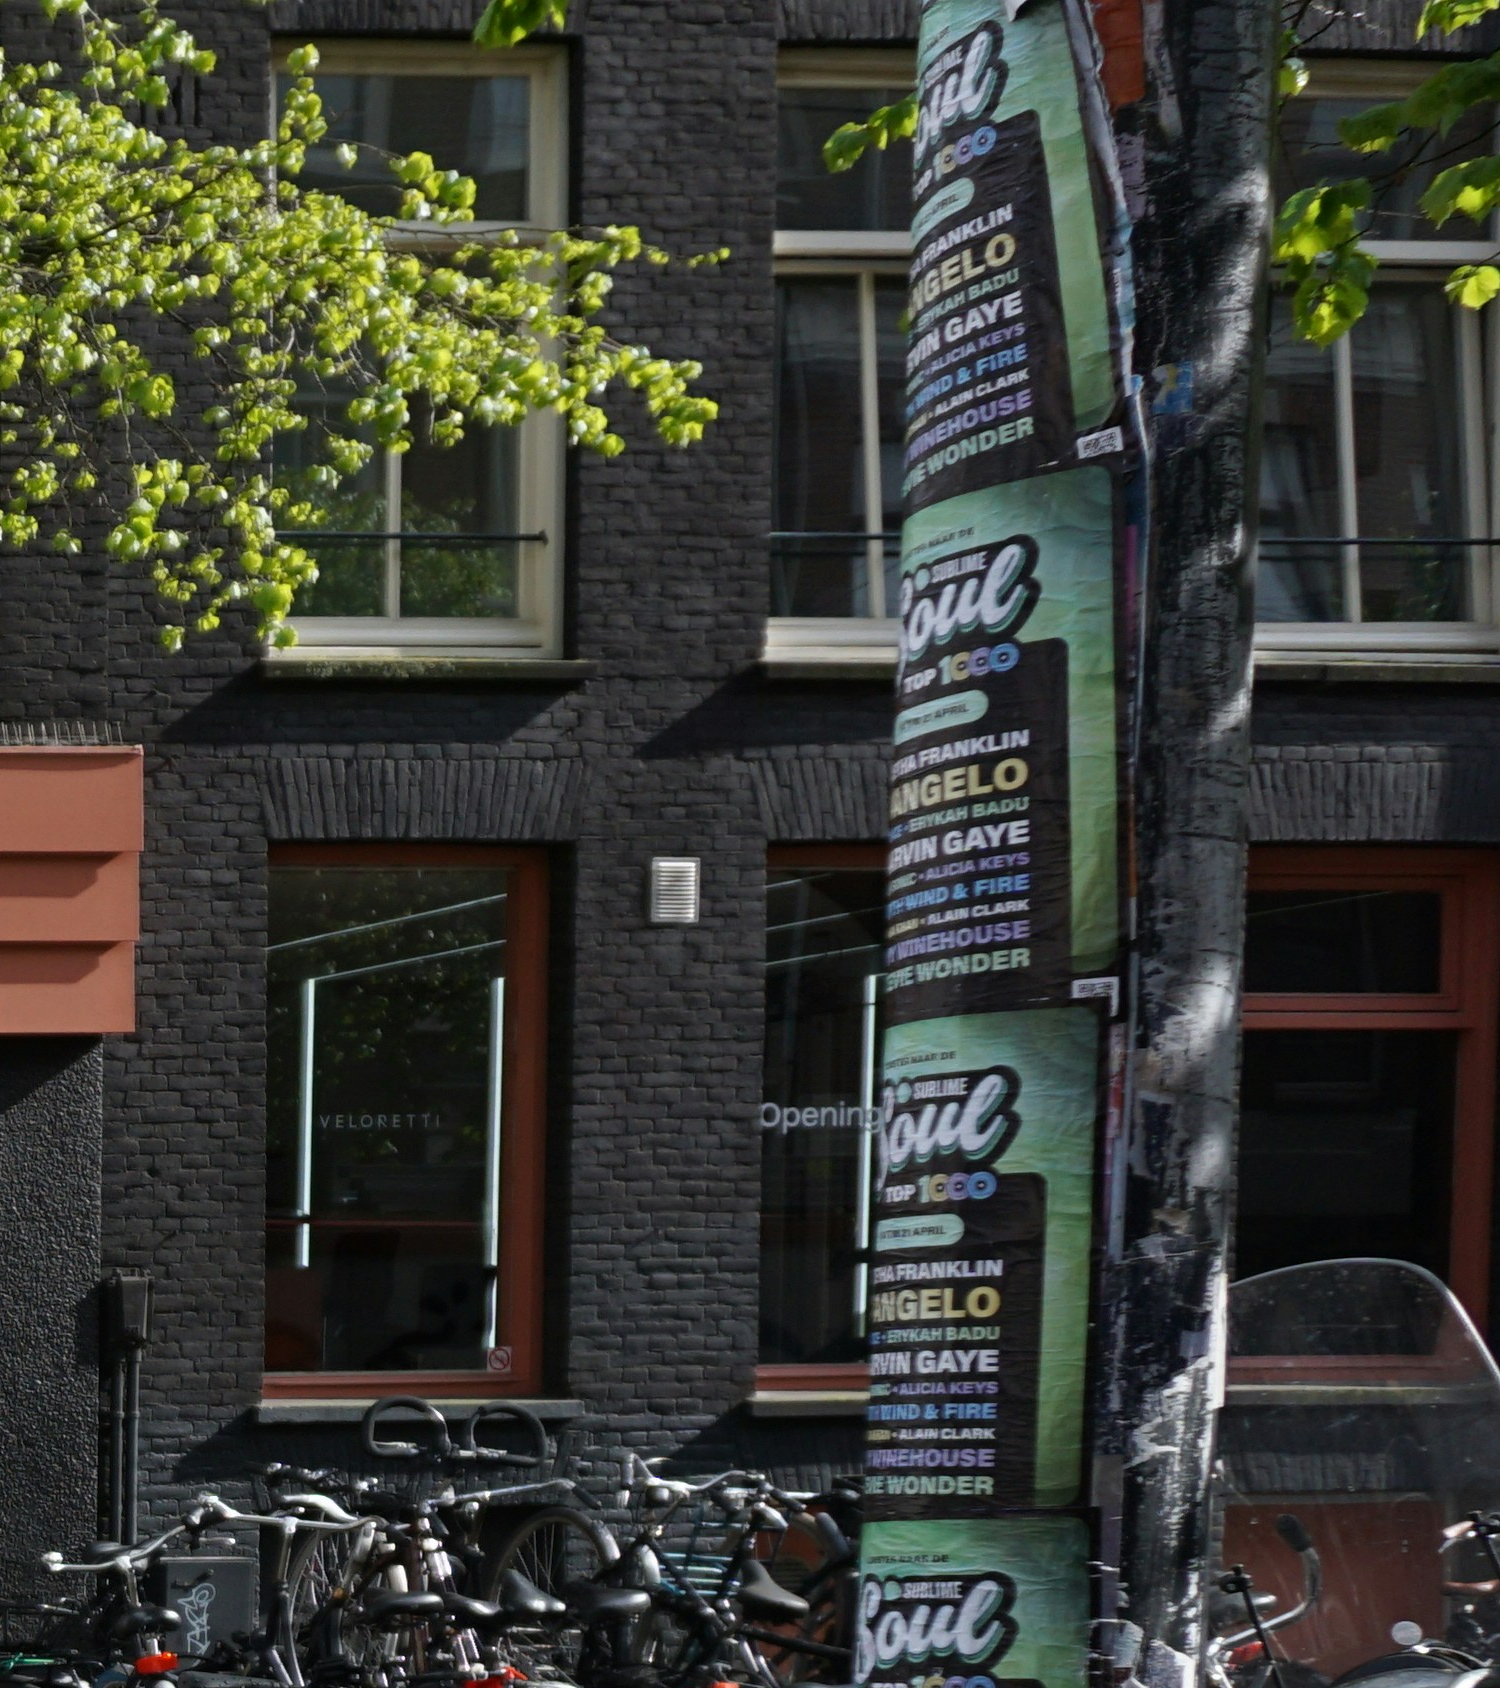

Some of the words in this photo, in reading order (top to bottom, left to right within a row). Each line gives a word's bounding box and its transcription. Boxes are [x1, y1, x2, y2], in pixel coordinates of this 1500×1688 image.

[921, 203, 1013, 263] FRANKLIN
[968, 267, 1020, 300] BADU
[944, 290, 1024, 343] GAYE
[978, 322, 1026, 350] KEYS
[957, 366, 972, 385] &
[975, 342, 1029, 377] FIRE
[975, 366, 1031, 397] CLARK
[927, 416, 1036, 475] WONDER
[930, 551, 988, 583] SUBLIME
[904, 668, 937, 693] TOP
[938, 643, 1021, 685] 1000
[917, 729, 1030, 769] FRANKLIN
[909, 806, 969, 832] ERYKAH
[972, 796, 1030, 818] BADU
[942, 819, 1031, 855] GAYE
[925, 859, 977, 881] ALICIA
[979, 852, 1031, 870] KEYS
[905, 886, 949, 913] WIND
[953, 883, 970, 900] &
[974, 873, 1031, 897] FIRE
[927, 907, 970, 925] ALAIN
[971, 899, 1030, 917] CLARK
[898, 919, 1032, 961] WINEHOUSE
[915, 947, 1031, 983] WONDER
[913, 1077, 969, 1100] SUBLIME
[318, 1113, 442, 1130] VELORETTI
[760, 1102, 883, 1138] Opening
[884, 1184, 916, 1204] TOP
[917, 1170, 998, 1203] 1000
[912, 1225, 947, 1237] APRIL
[895, 1259, 1004, 1282] FRANKLIN
[886, 1328, 942, 1344] ERYKAH
[946, 1326, 1001, 1341] BADU
[870, 1351, 911, 1376] RVIN
[916, 1349, 1000, 1374] GAYE
[899, 1381, 947, 1395] ALICIA
[949, 1381, 1000, 1395] KEYS
[880, 1404, 921, 1420] WIND
[923, 1403, 940, 1419] &
[944, 1403, 998, 1419] FIRE
[899, 1428, 940, 1440] ALAIN
[940, 1428, 997, 1440] CLARK
[871, 1448, 996, 1468] WINEHOUSE
[886, 1475, 996, 1495] WONDER
[902, 1581, 964, 1599] SUBLIME
[854, 1579, 1003, 1686] Soul
